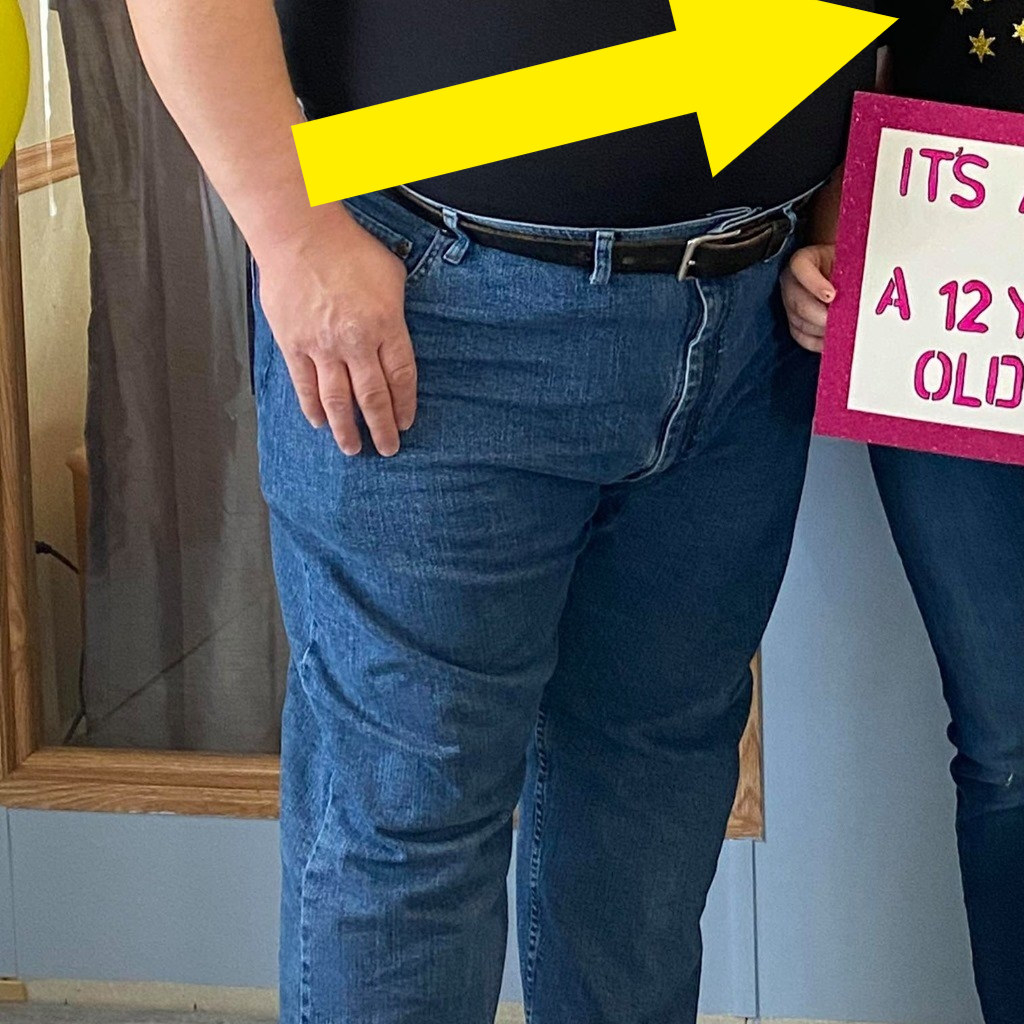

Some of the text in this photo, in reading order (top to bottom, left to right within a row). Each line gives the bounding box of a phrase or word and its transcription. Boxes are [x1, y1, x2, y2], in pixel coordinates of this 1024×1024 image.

[899, 146, 990, 210] IT'S
[874, 265, 911, 321] A
[938, 279, 993, 334] 12
